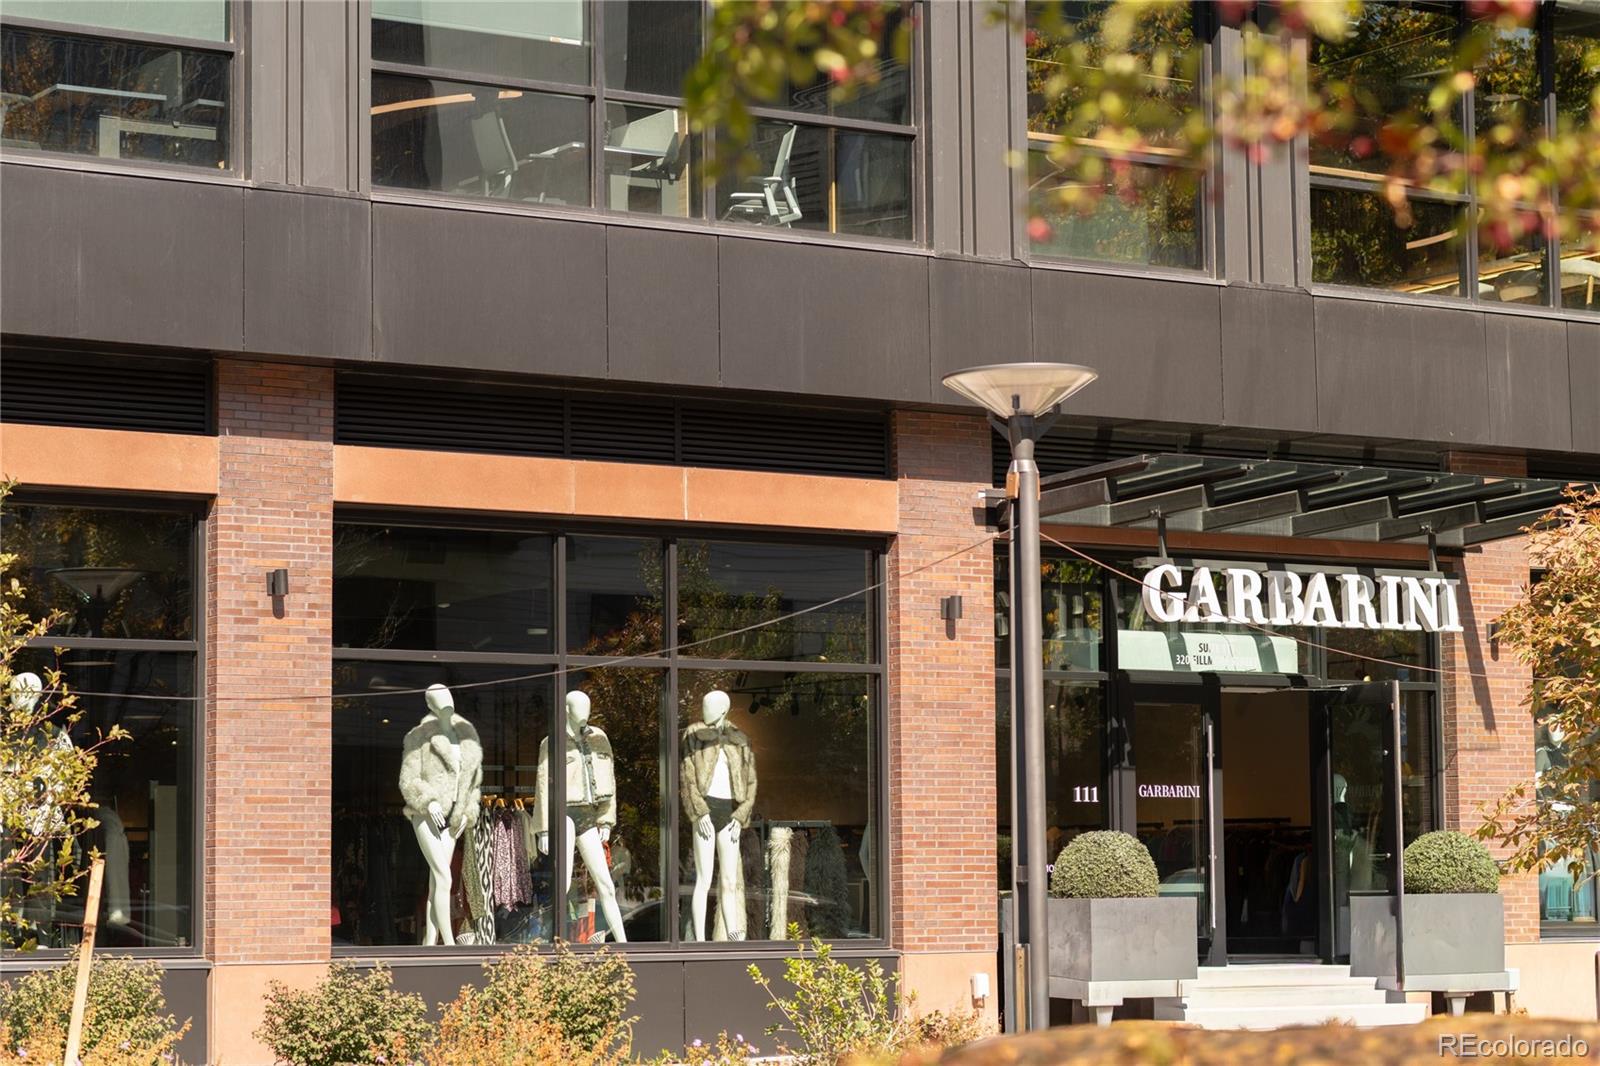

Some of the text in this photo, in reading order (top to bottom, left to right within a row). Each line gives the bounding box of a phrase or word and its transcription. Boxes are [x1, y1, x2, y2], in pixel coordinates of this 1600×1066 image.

[1142, 564, 1464, 633] GARBARINI
[1073, 786, 1099, 803] 111
[1138, 784, 1201, 798] GARBARINI
